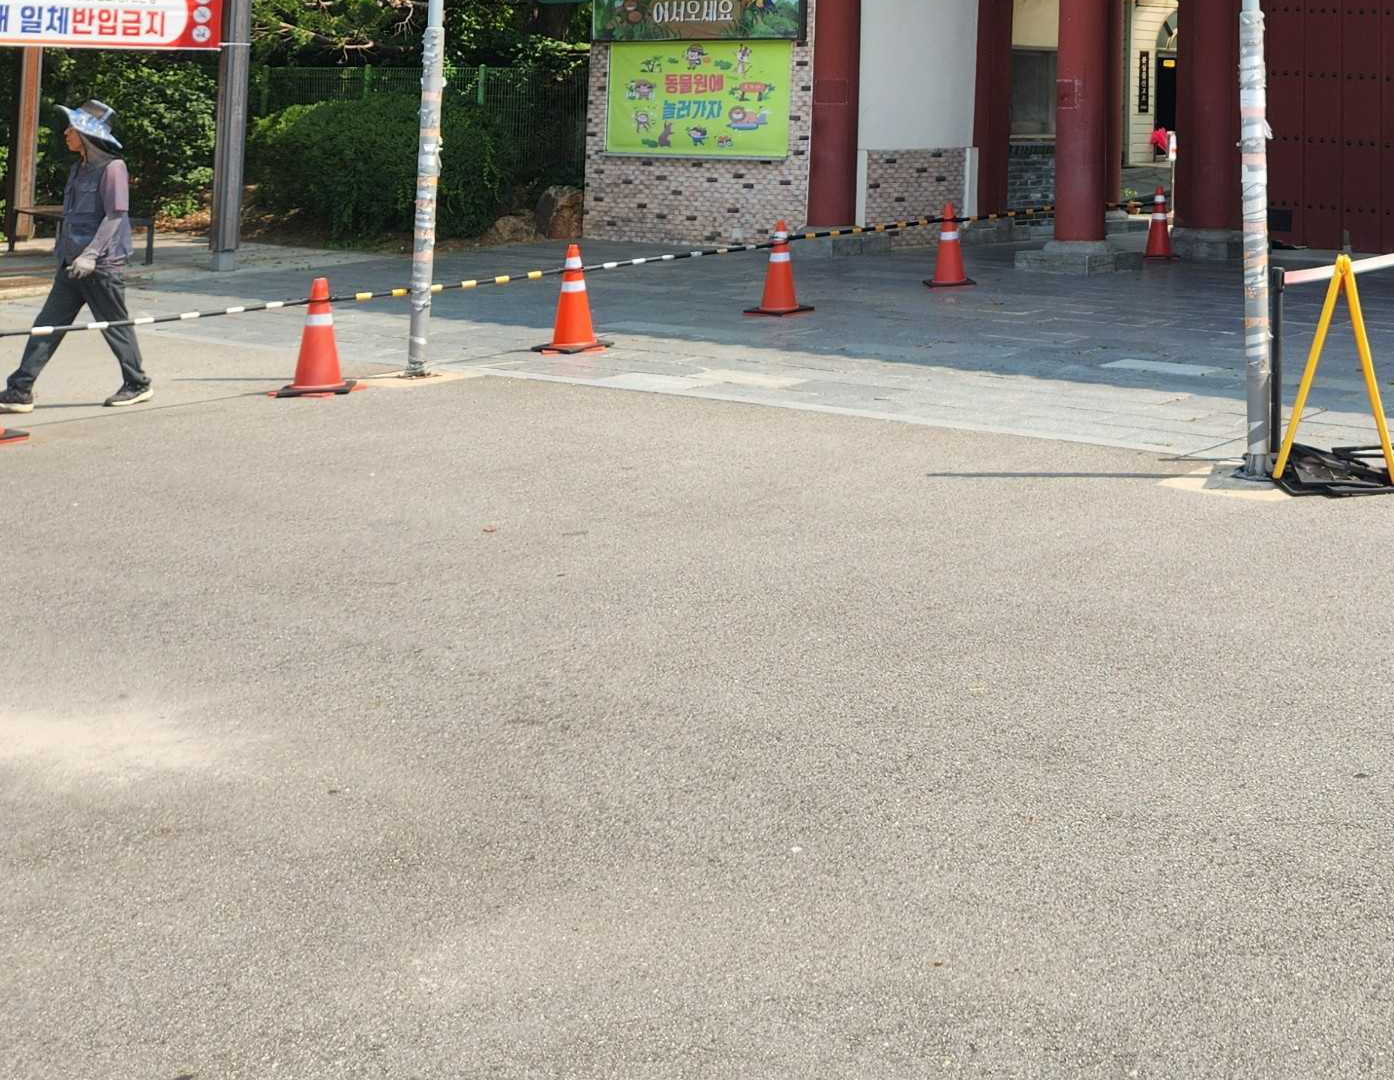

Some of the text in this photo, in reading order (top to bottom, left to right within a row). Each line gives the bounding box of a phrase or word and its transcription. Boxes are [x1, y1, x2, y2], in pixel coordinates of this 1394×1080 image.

[652, 0, 734, 24] 어서오세요
[664, 74, 724, 94] 동물원에
[662, 100, 723, 120] 놀러가자
